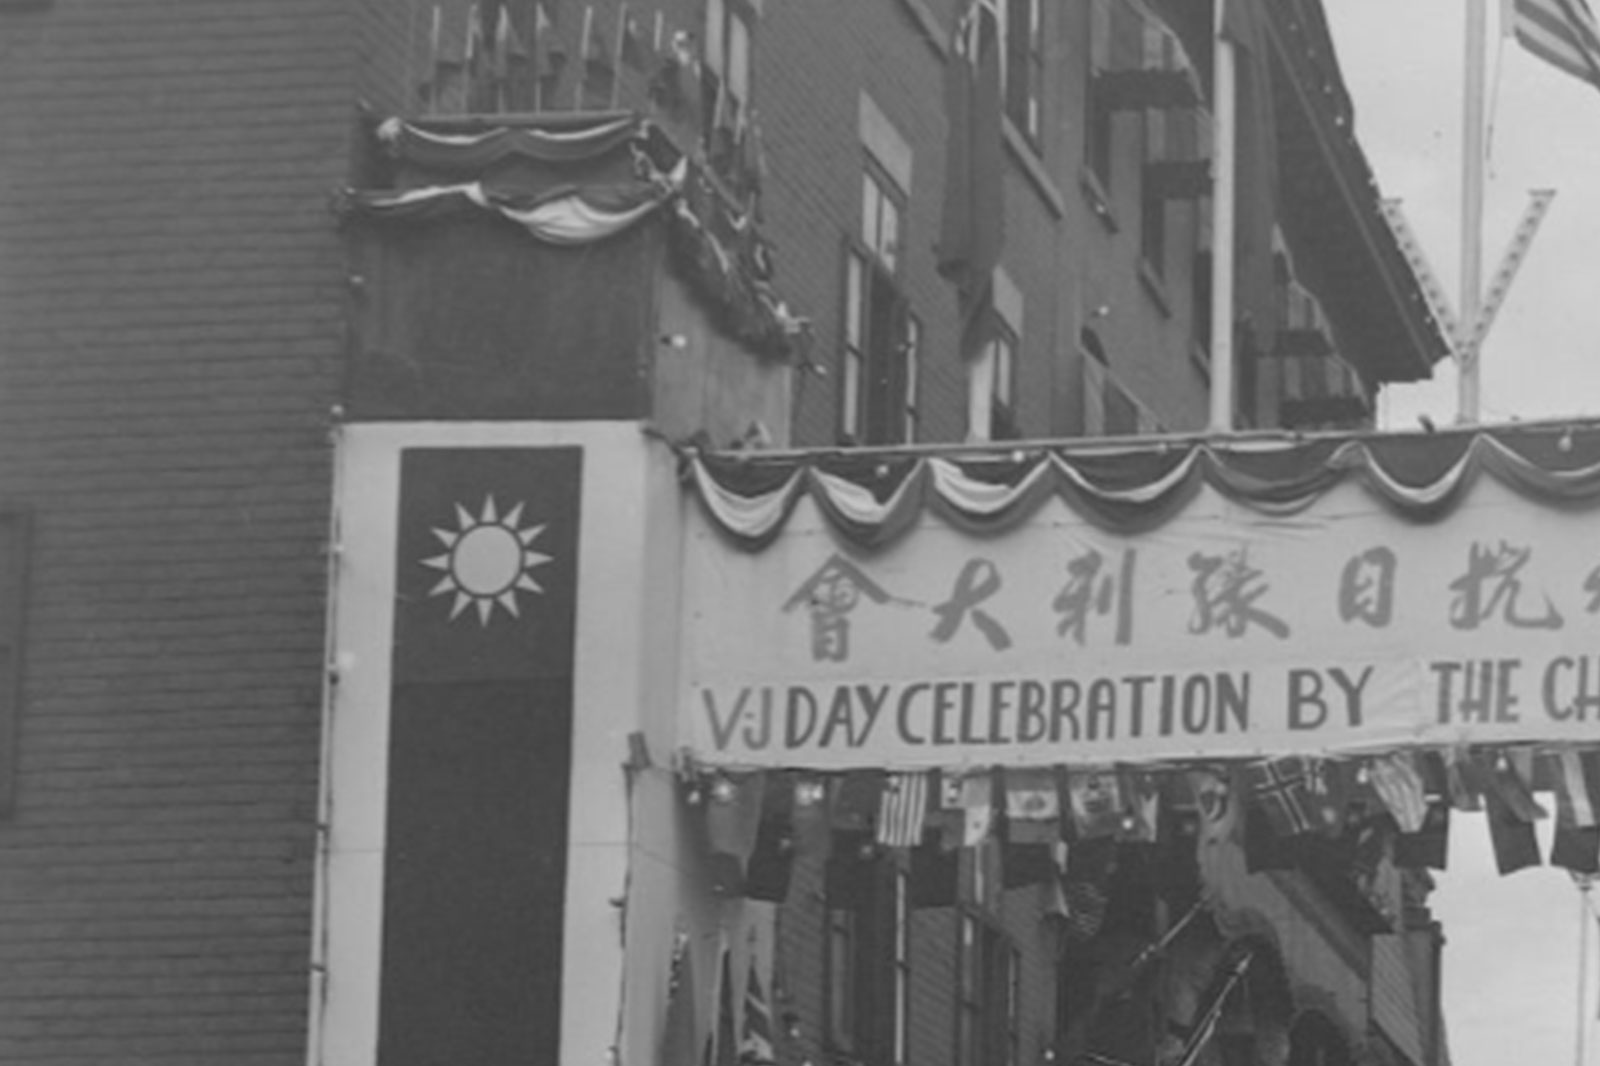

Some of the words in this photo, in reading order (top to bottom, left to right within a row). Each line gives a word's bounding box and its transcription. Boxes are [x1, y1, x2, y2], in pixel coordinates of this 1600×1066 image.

[783, 683, 892, 748] DAY
[896, 671, 1250, 747] CELEBRATION
[1287, 665, 1374, 731] BY
[1430, 659, 1521, 724] THE
